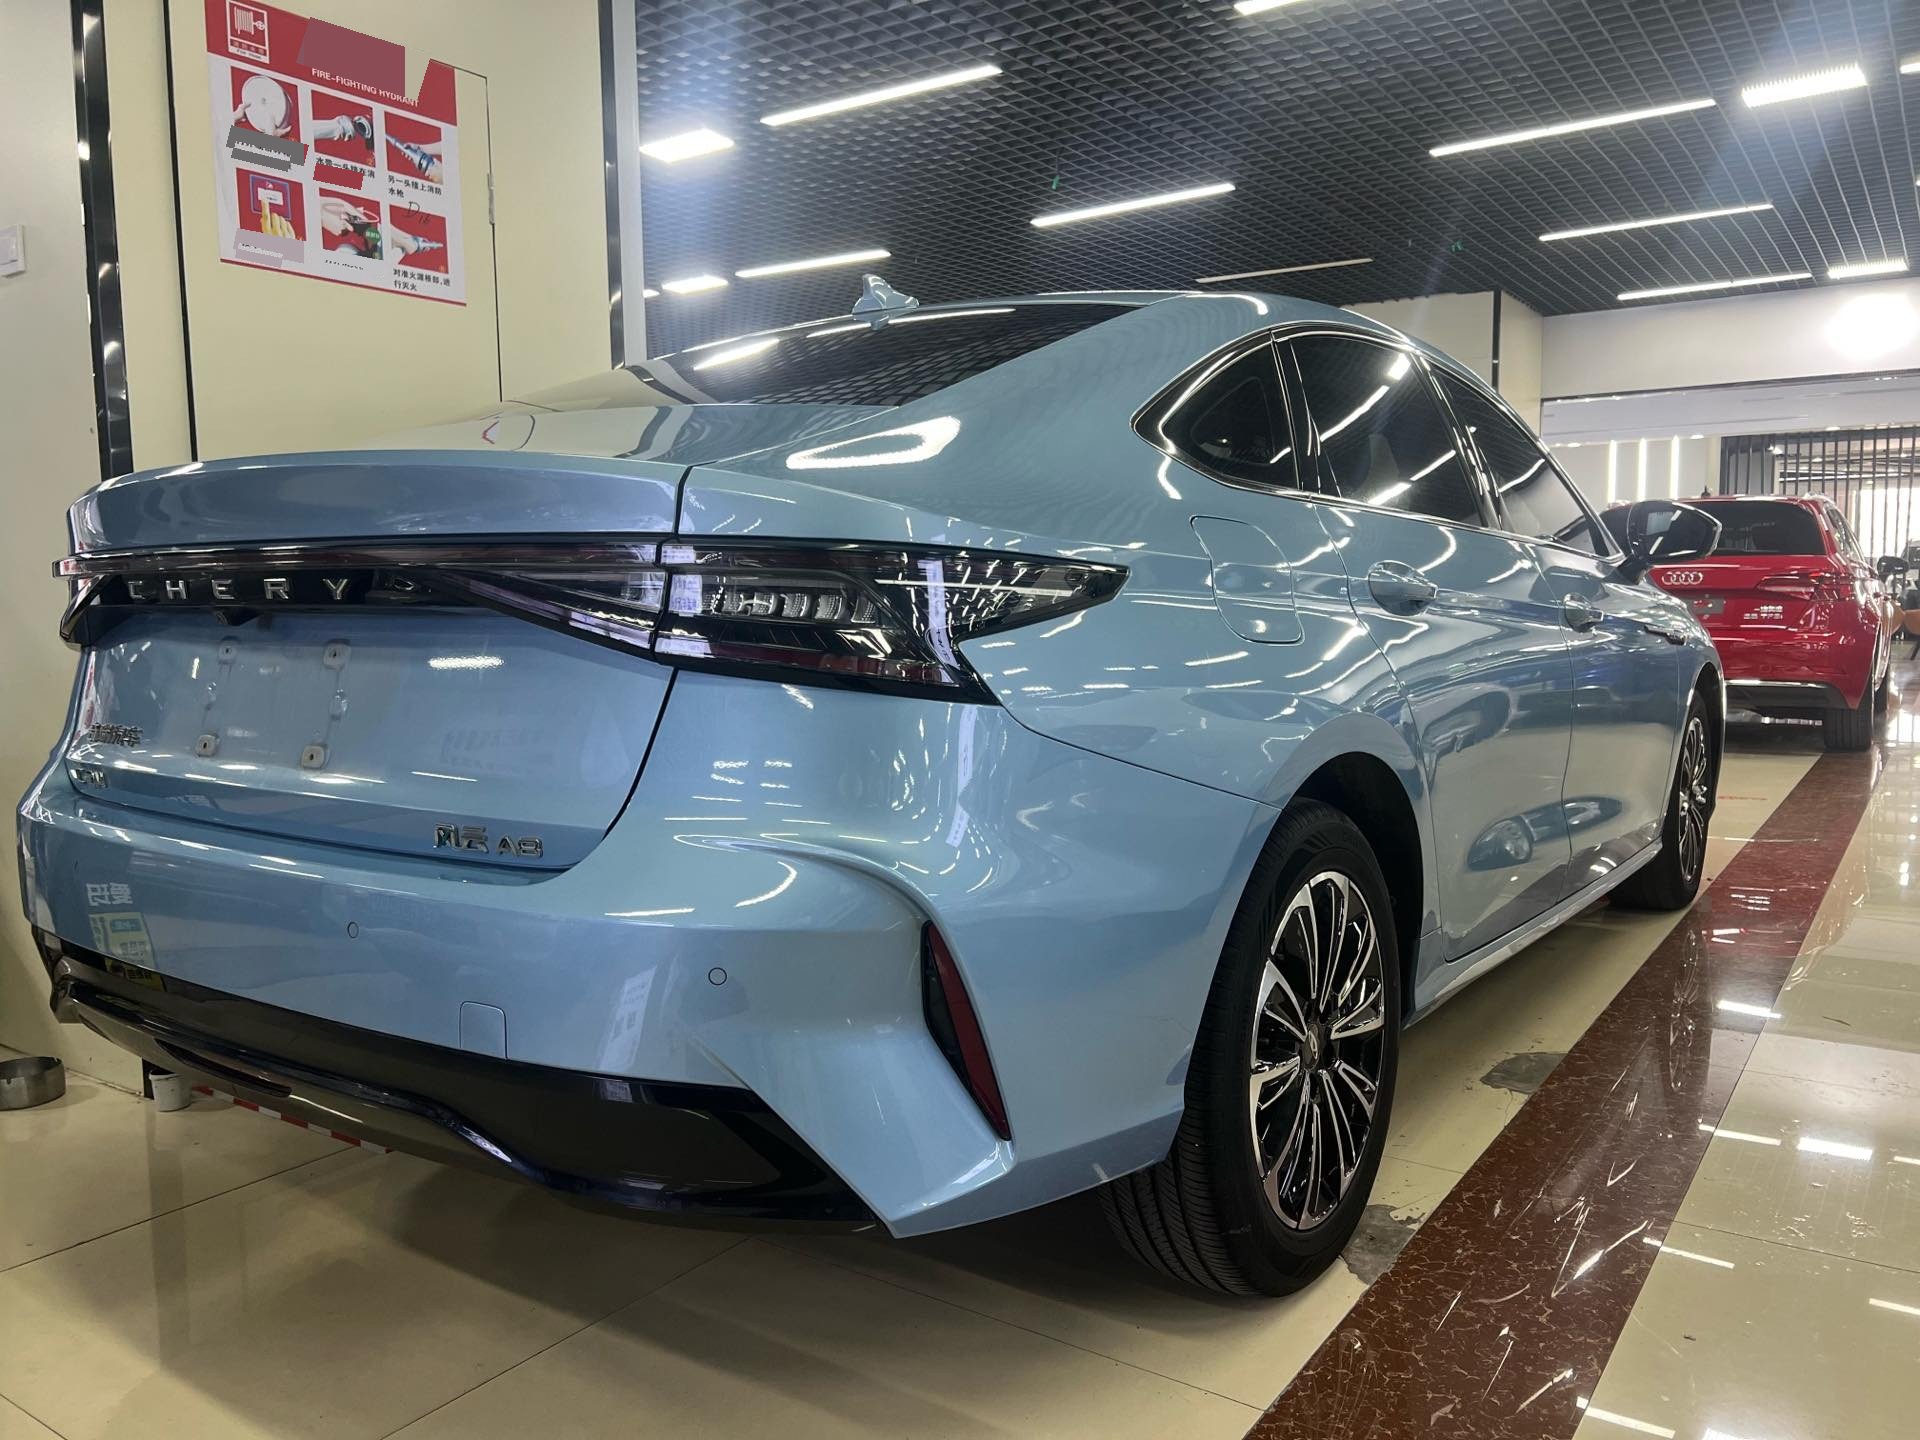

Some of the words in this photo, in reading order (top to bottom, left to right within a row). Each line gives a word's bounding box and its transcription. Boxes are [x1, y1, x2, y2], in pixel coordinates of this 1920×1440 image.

[311, 68, 377, 95] FIRE-FIGHTING
[379, 89, 419, 107] HYDRANT
[128, 578, 349, 600] CHERY
[433, 822, 489, 854] 风云
[496, 834, 544, 858] A8
